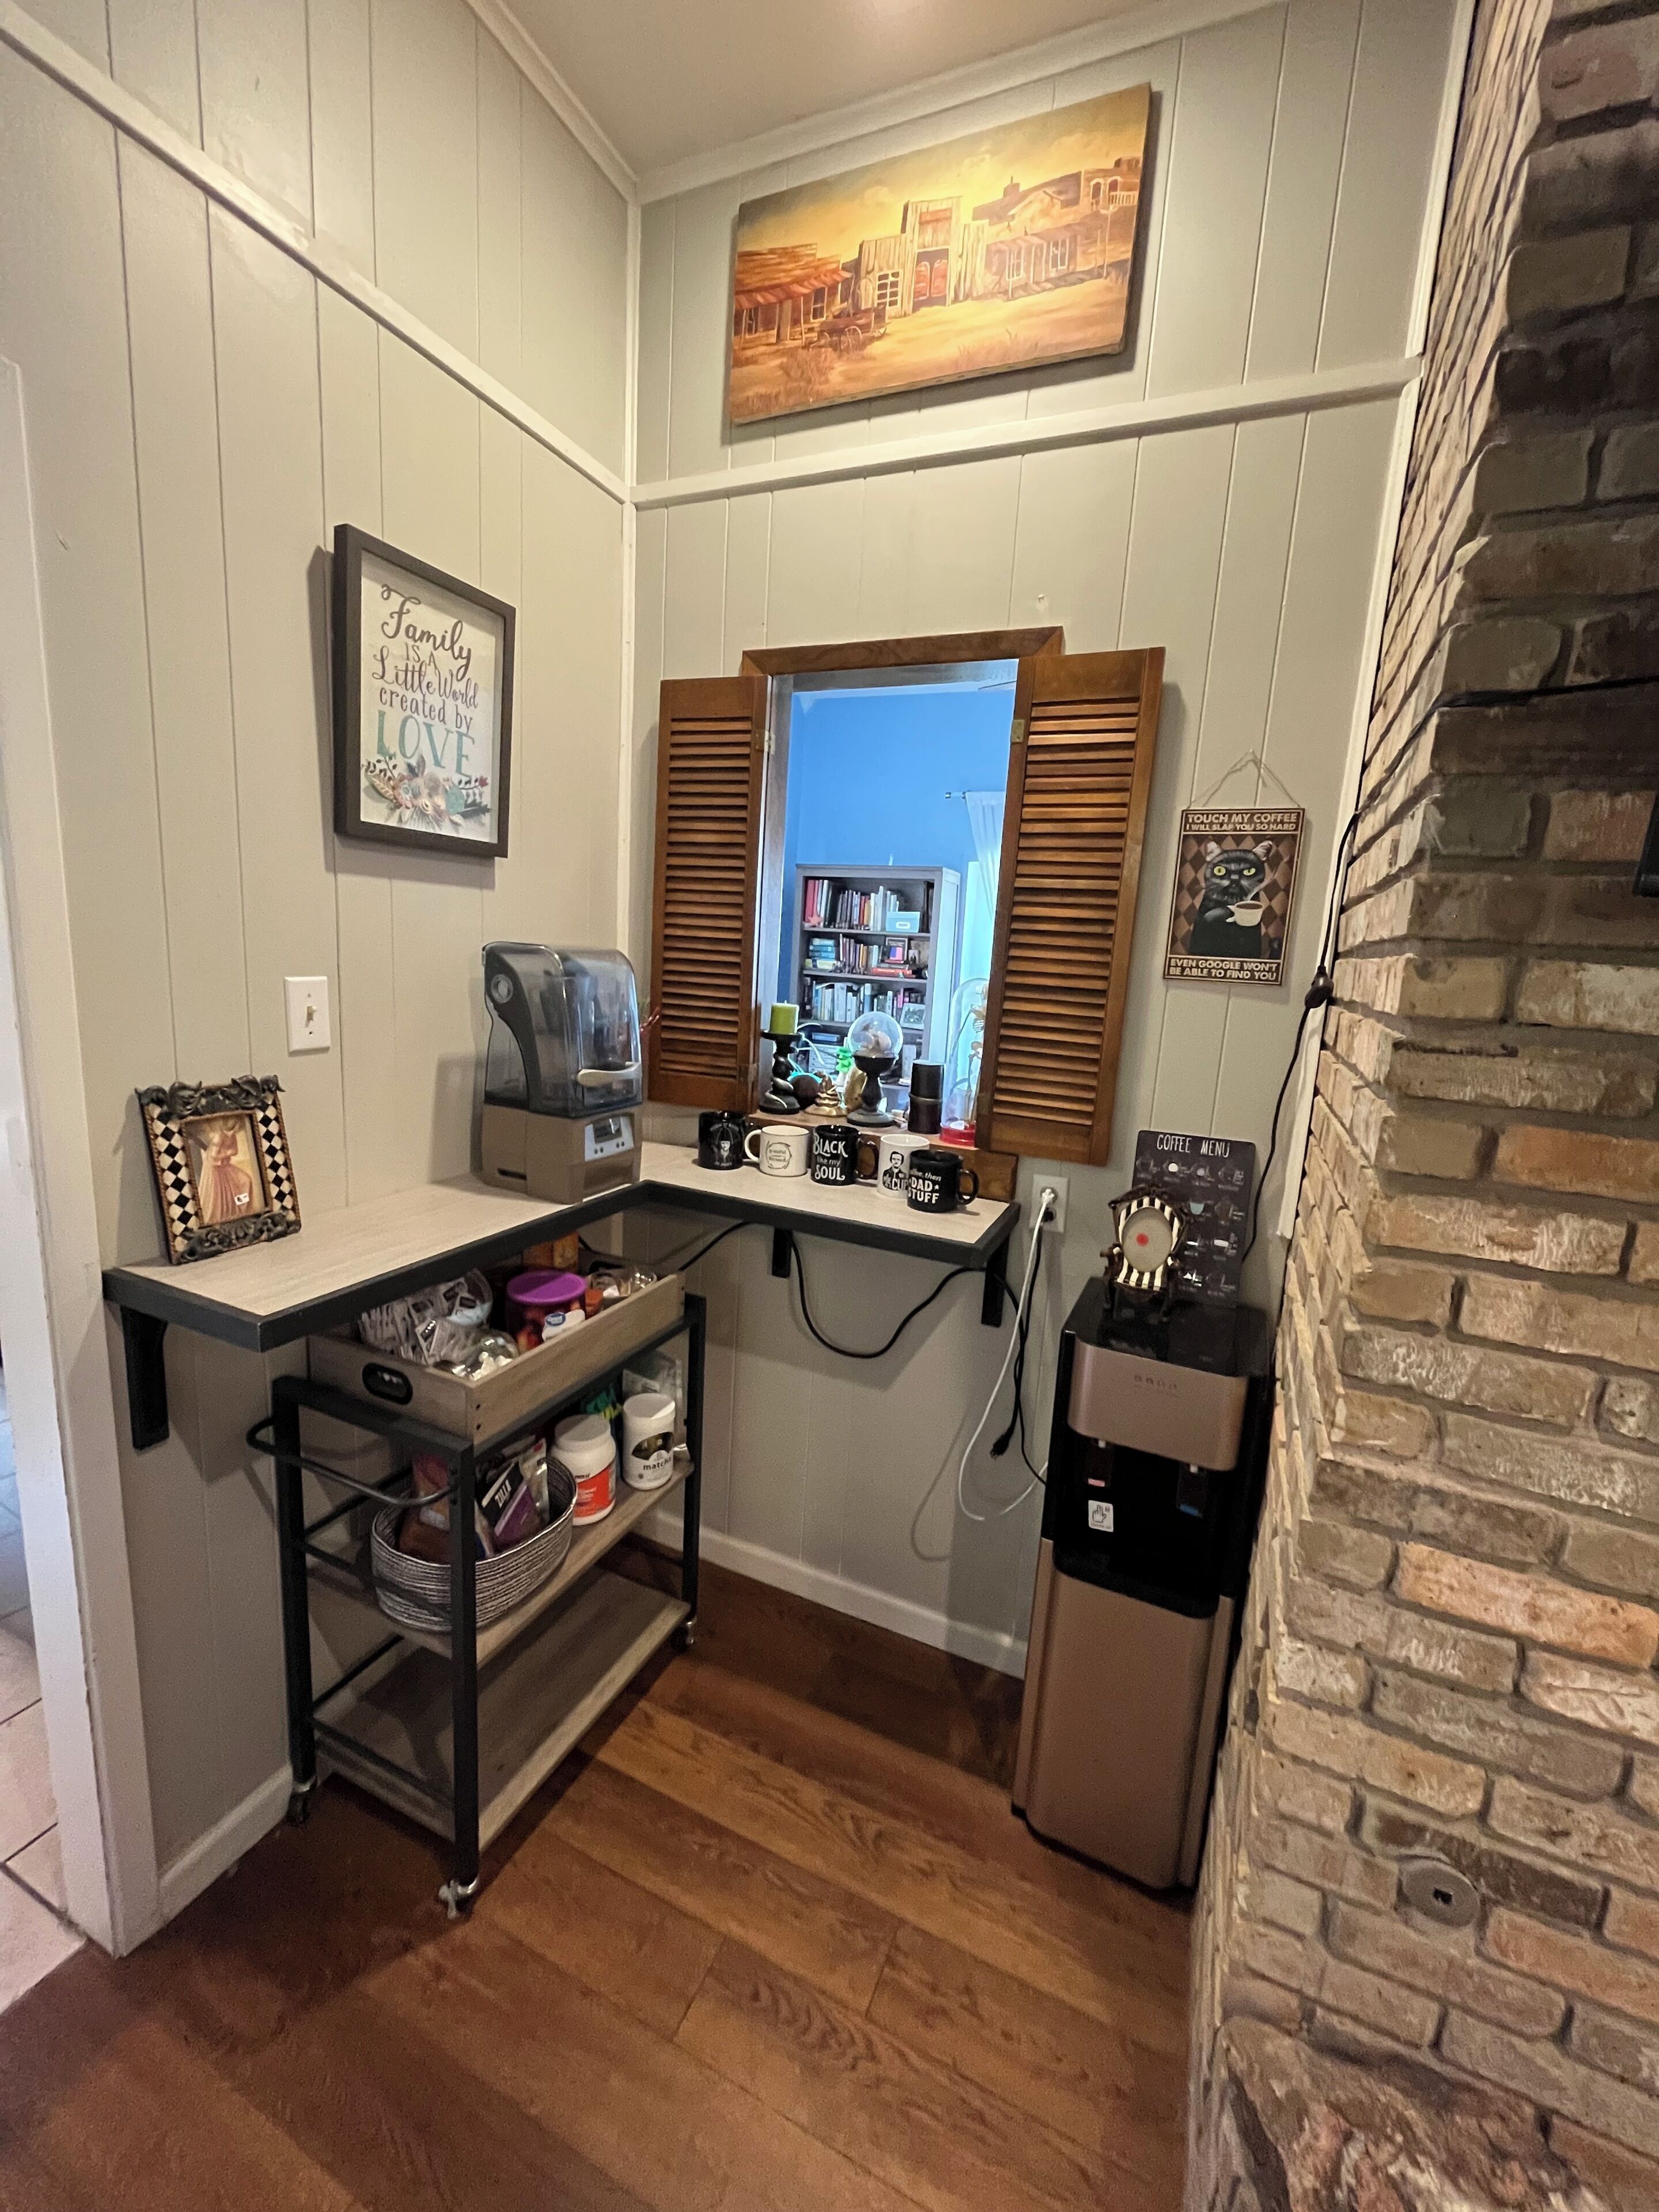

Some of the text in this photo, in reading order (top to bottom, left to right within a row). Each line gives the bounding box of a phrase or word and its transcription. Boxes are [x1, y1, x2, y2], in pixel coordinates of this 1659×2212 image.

[381, 584, 472, 681] Family
[404, 642, 438, 669] IS A
[372, 646, 479, 710] Little World
[379, 687, 473, 733] created by
[377, 709, 476, 779] LOVE
[1188, 813, 1298, 823] TOUCH MY COFFEE
[1169, 967, 1277, 980] BE ABLE TO FIND YOU
[1171, 959, 1278, 972] EVEN GOOGLE WON'T
[813, 1132, 848, 1158] BLACK
[1157, 1134, 1230, 1158] COFFEE MENU
[815, 1164, 846, 1181] SOUL
[829, 1160, 841, 1168] my
[911, 1176, 933, 1192] DAD
[925, 1172, 942, 1181] then
[908, 1187, 940, 1204] STUFF
